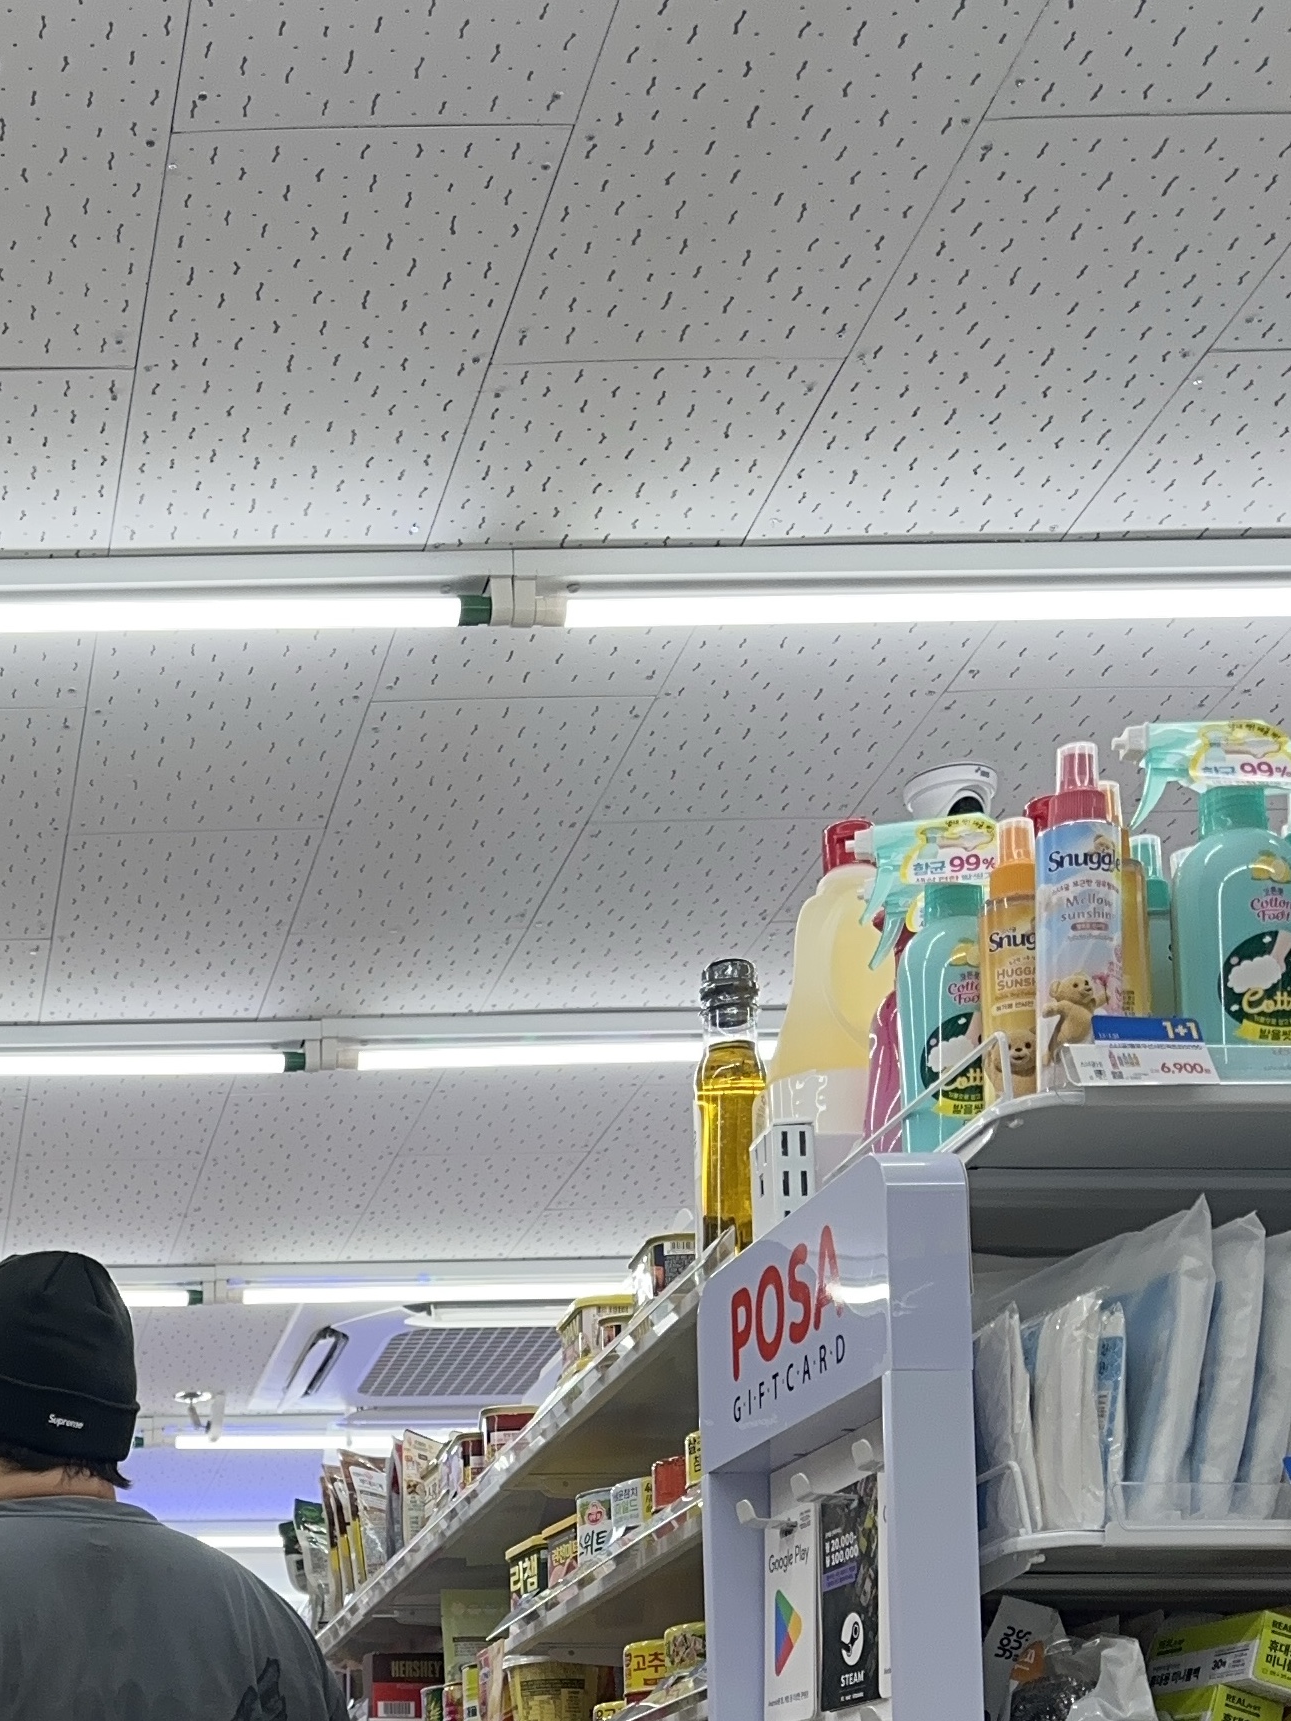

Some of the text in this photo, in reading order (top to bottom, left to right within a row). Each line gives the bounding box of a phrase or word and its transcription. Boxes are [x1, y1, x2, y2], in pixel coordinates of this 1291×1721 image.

[950, 854, 996, 873] 99%
[1162, 1021, 1200, 1041] 1+1
[731, 1224, 845, 1383] POSA
[48, 1413, 84, 1430] Supreme
[769, 1544, 810, 1574] Google Play
[510, 1555, 538, 1596] 리챔
[633, 1651, 666, 1673] 고추
[840, 1670, 865, 1688] STEAM
